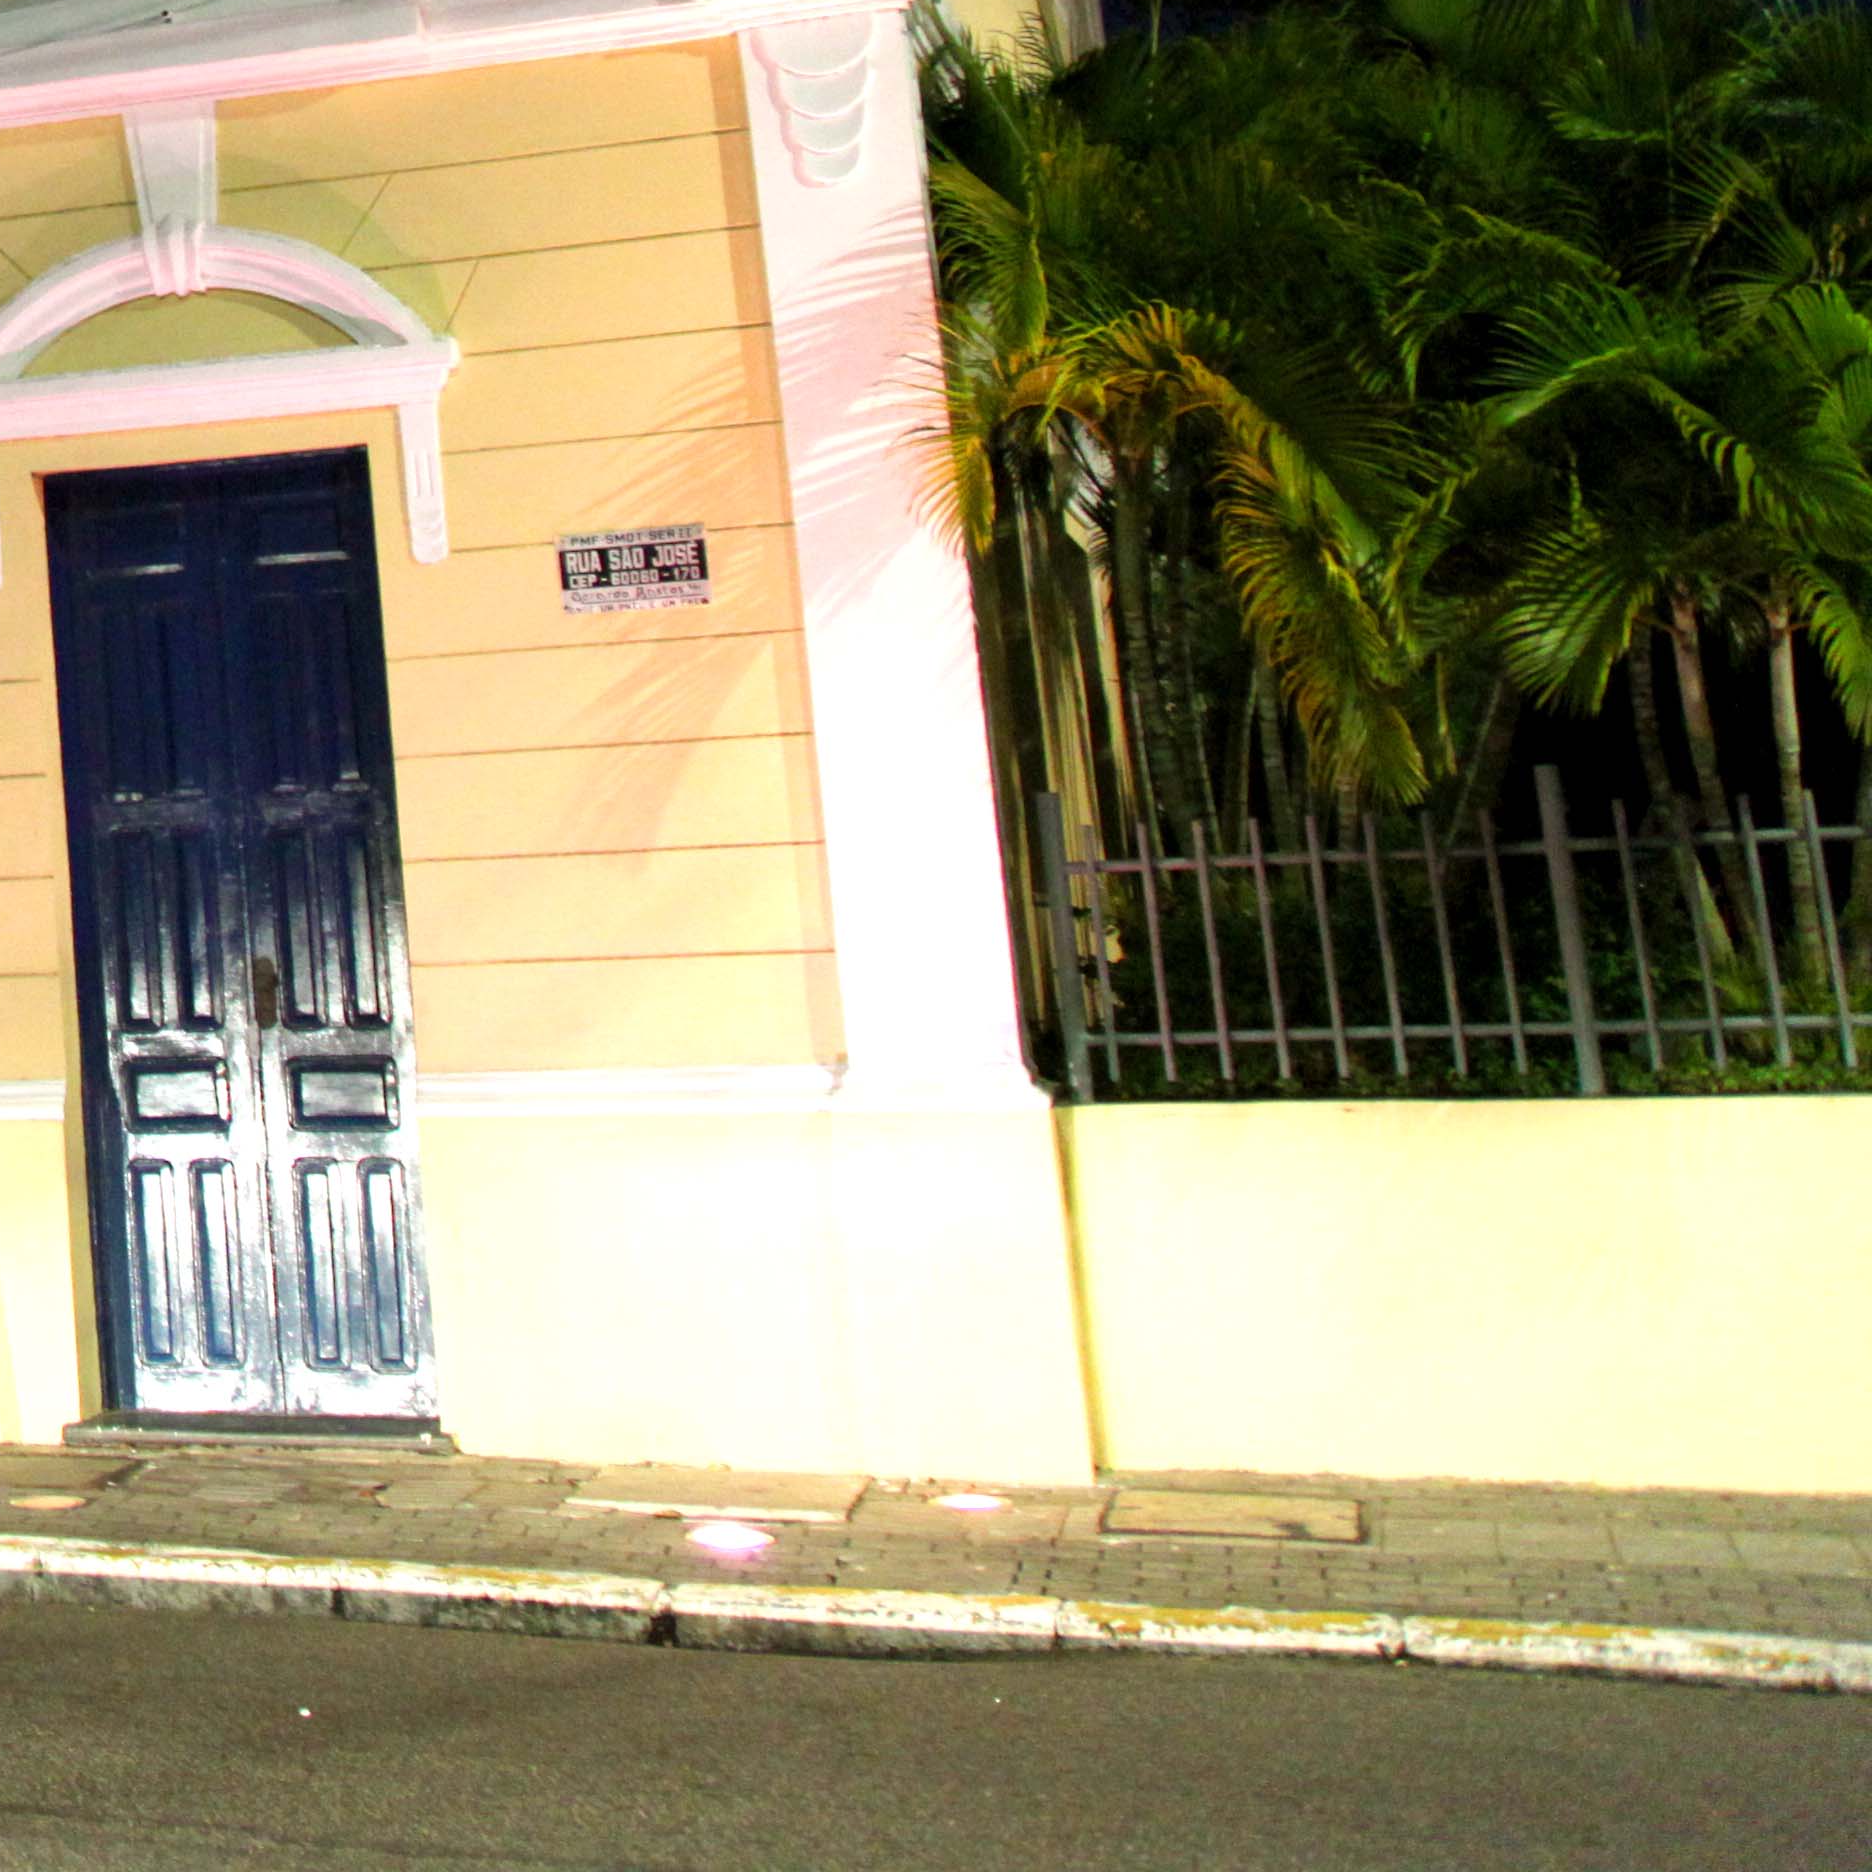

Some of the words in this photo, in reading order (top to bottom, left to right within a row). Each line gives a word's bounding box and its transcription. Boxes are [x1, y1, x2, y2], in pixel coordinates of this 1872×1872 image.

[564, 550, 602, 574] RUA
[652, 540, 699, 567] JOSÉ
[568, 574, 598, 589] CEP
